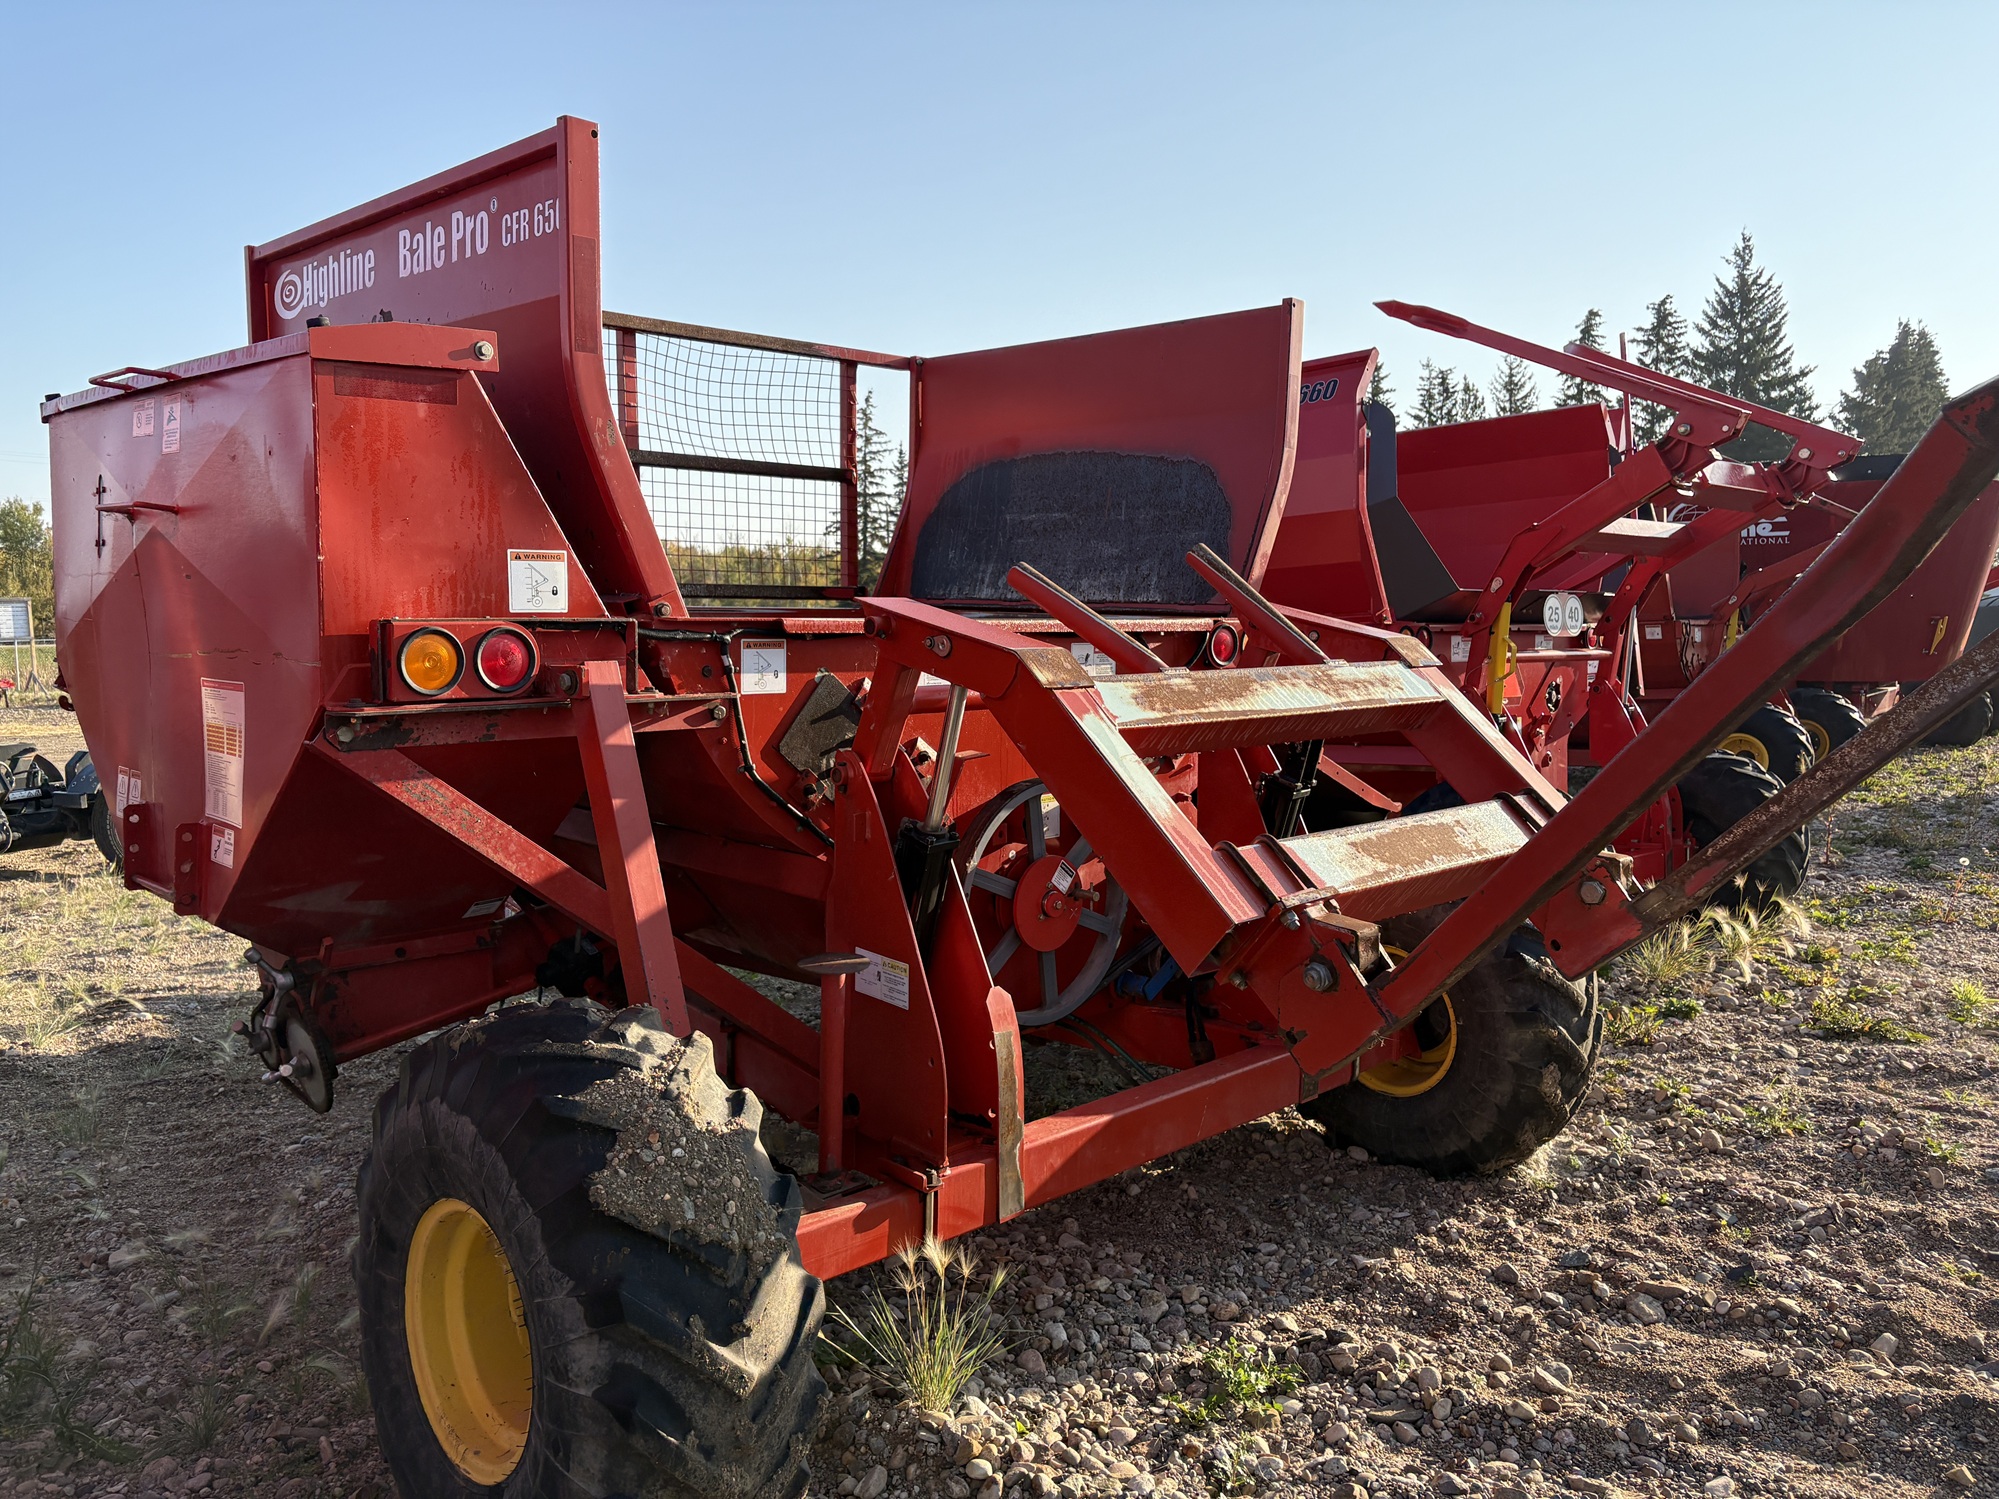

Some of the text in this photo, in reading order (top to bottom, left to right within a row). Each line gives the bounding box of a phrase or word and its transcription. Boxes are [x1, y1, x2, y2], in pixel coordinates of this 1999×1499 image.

[303, 248, 375, 308] Highline
[398, 220, 446, 279] Bale
[501, 208, 530, 247] CFR
[1300, 377, 1339, 405] 660
[1547, 605, 1560, 623] 25
[1568, 606, 1580, 623] 40
